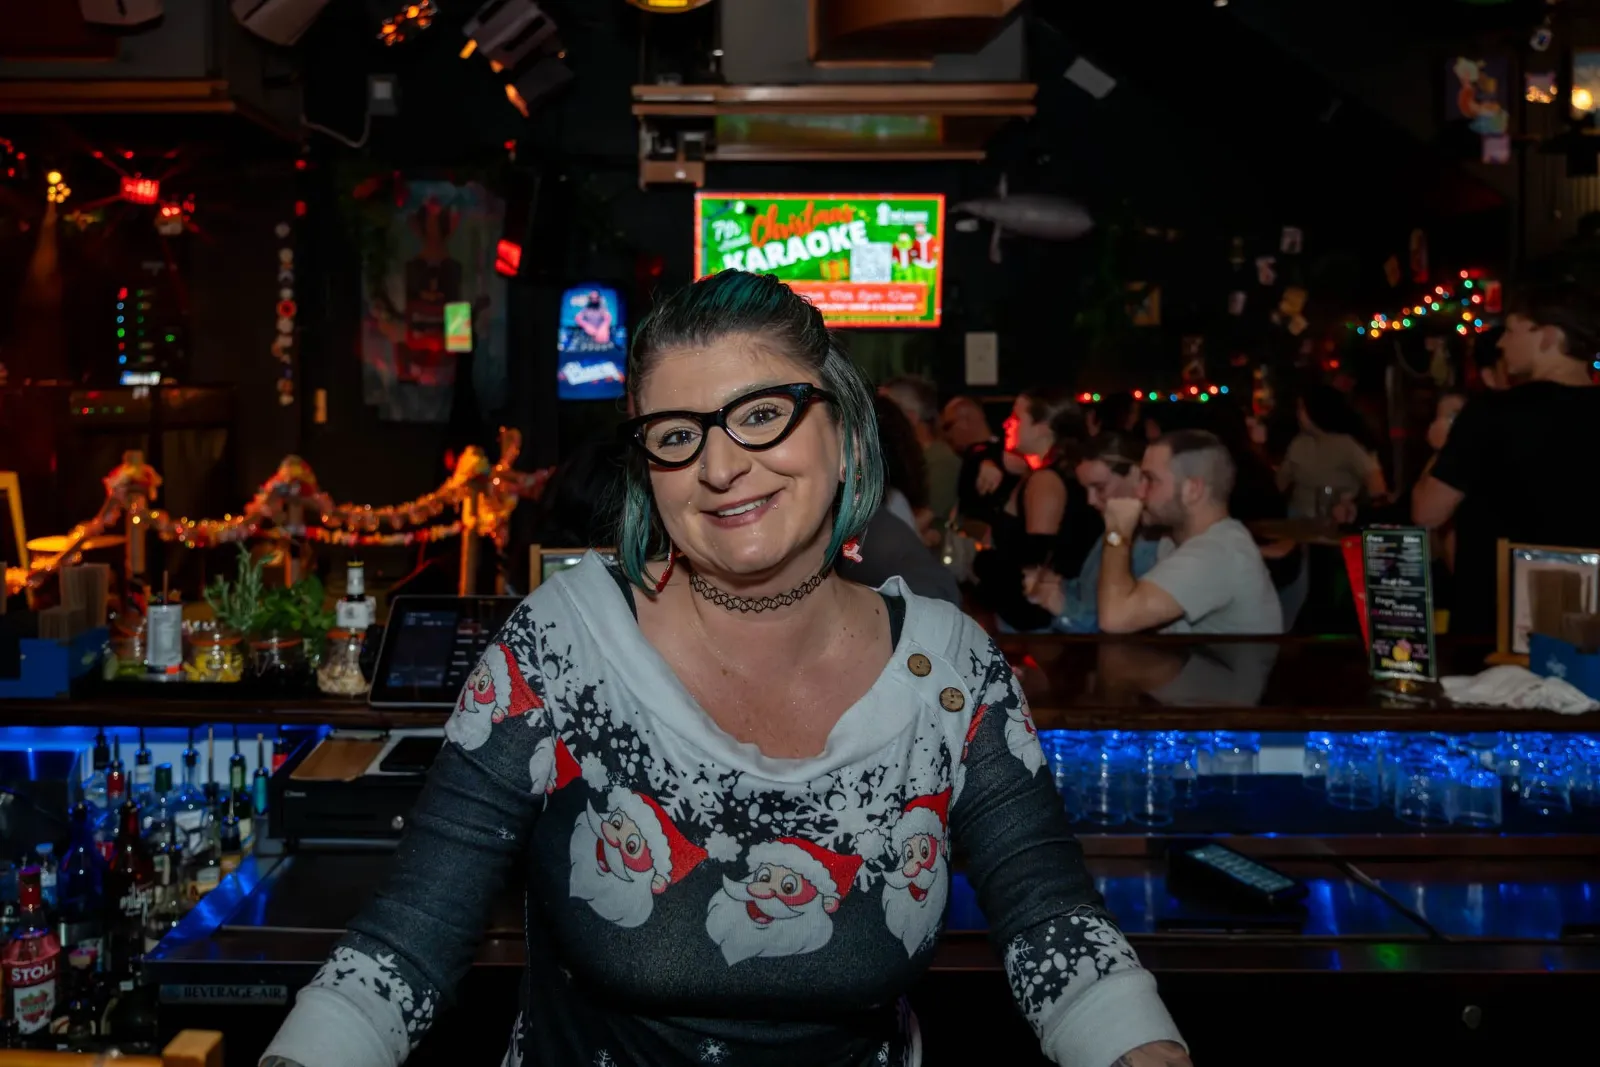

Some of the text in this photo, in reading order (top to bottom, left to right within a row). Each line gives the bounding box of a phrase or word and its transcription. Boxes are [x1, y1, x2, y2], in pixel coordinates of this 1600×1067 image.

[722, 220, 869, 273] KARAOKE
[11, 959, 56, 982] STOLI
[184, 986, 282, 999] BEVERAGE-AIR
